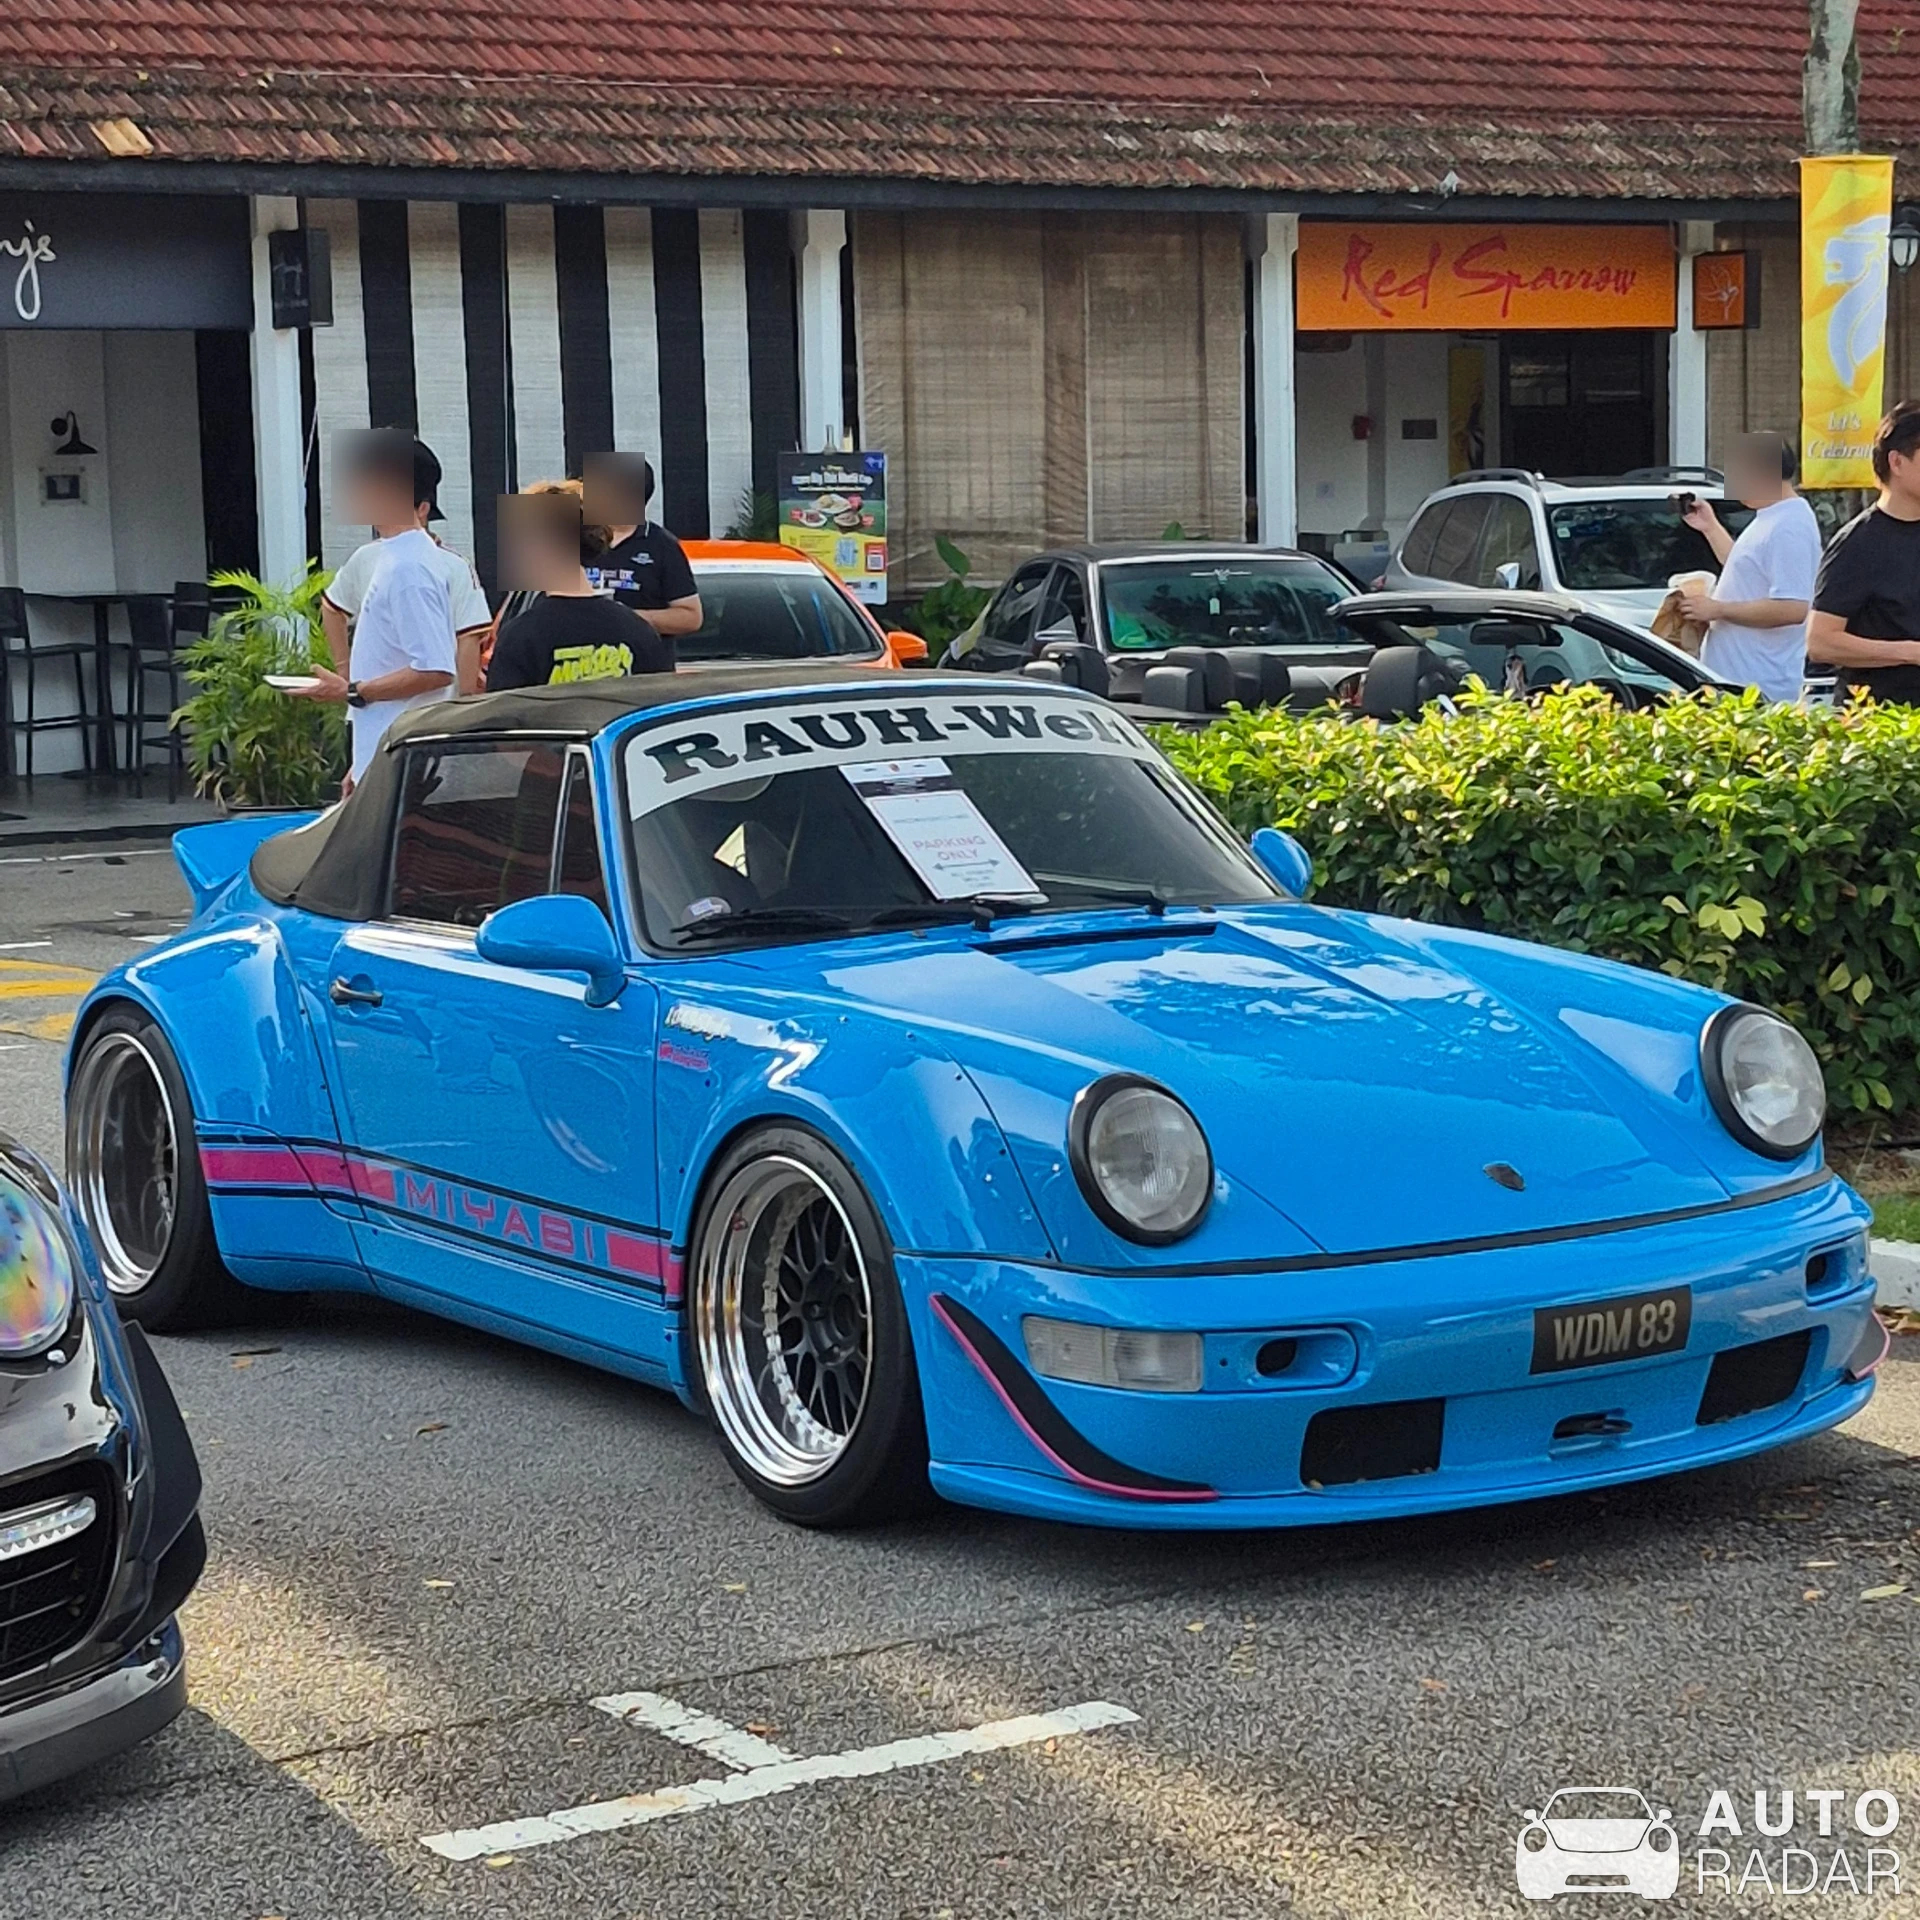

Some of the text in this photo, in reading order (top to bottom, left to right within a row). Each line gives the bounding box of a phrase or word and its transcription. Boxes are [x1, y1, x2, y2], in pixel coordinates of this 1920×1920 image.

[1342, 234, 1636, 318] Red Sparrow
[913, 835, 986, 850] PARKING
[937, 849, 979, 861] ONLY
[405, 1175, 595, 1261] MIYABI
[1554, 1299, 1677, 1362] WDM 83
